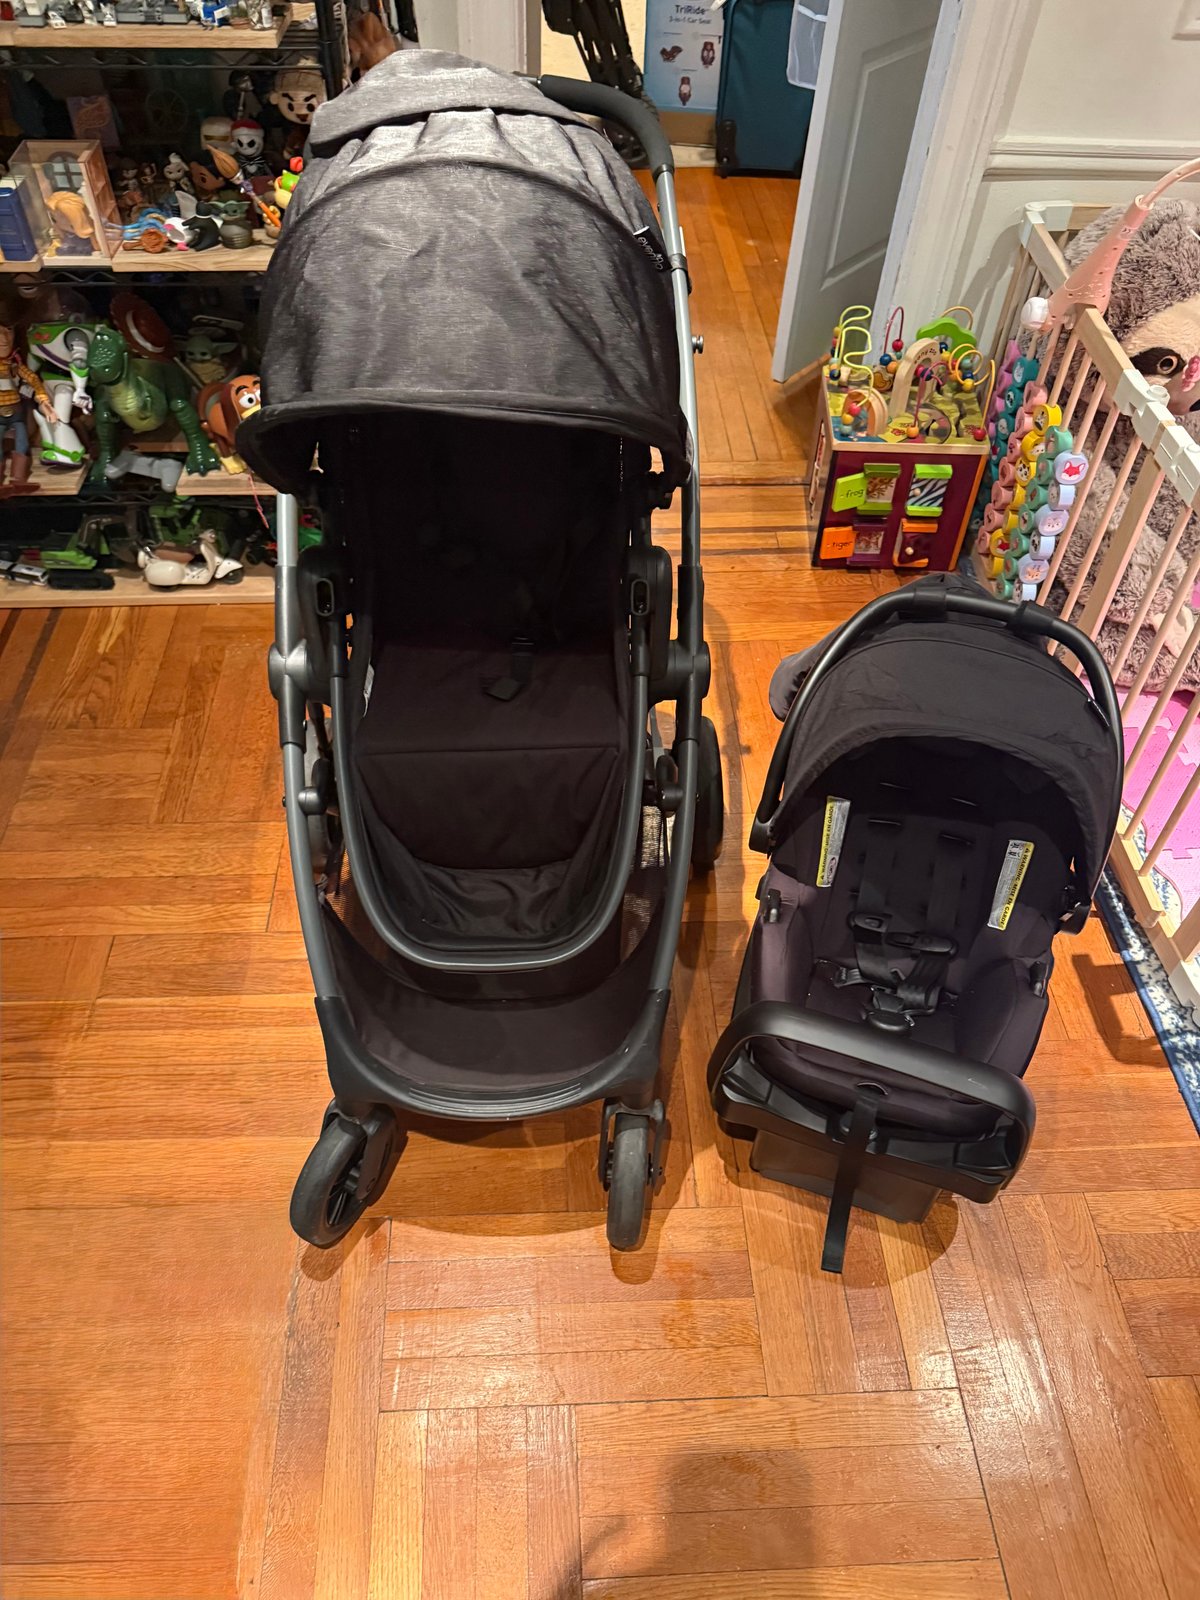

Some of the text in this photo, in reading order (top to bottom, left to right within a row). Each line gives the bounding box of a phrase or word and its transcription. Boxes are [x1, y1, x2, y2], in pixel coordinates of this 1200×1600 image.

[675, 4, 705, 15] TriRide
[846, 489, 864, 498] frog
[832, 541, 853, 551] tiger
[1015, 854, 1028, 881] WARNING
[1010, 884, 1018, 897] MISE
[1006, 898, 1013, 906] EN
